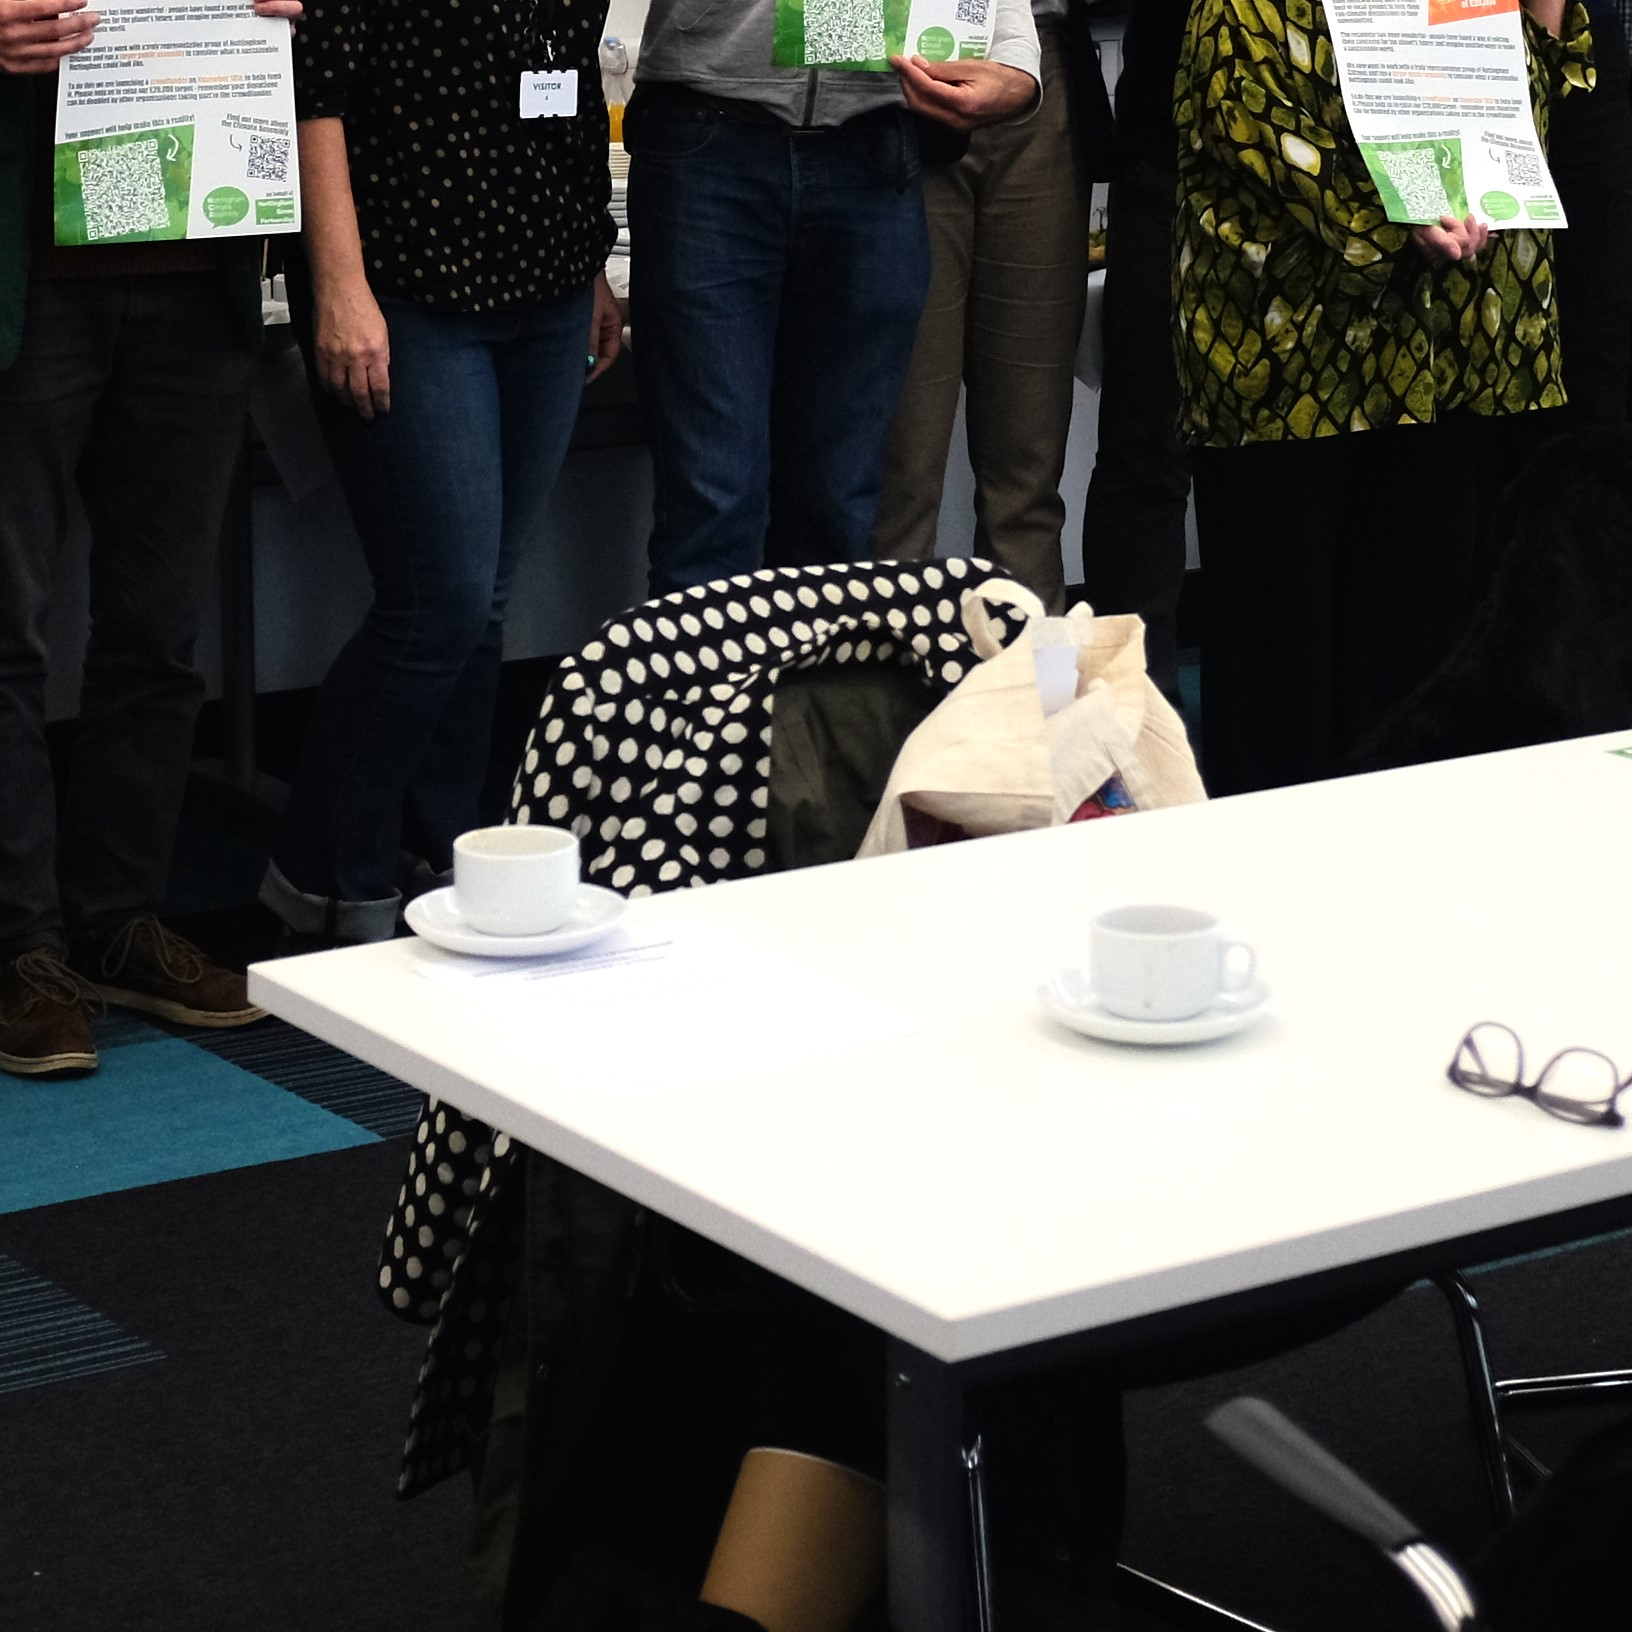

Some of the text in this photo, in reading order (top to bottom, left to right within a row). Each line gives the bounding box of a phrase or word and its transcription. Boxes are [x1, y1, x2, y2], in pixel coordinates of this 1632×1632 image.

[533, 82, 562, 92] VISITOR
[78, 126, 104, 138] support
[117, 122, 132, 133] help
[170, 114, 195, 126] reality!
